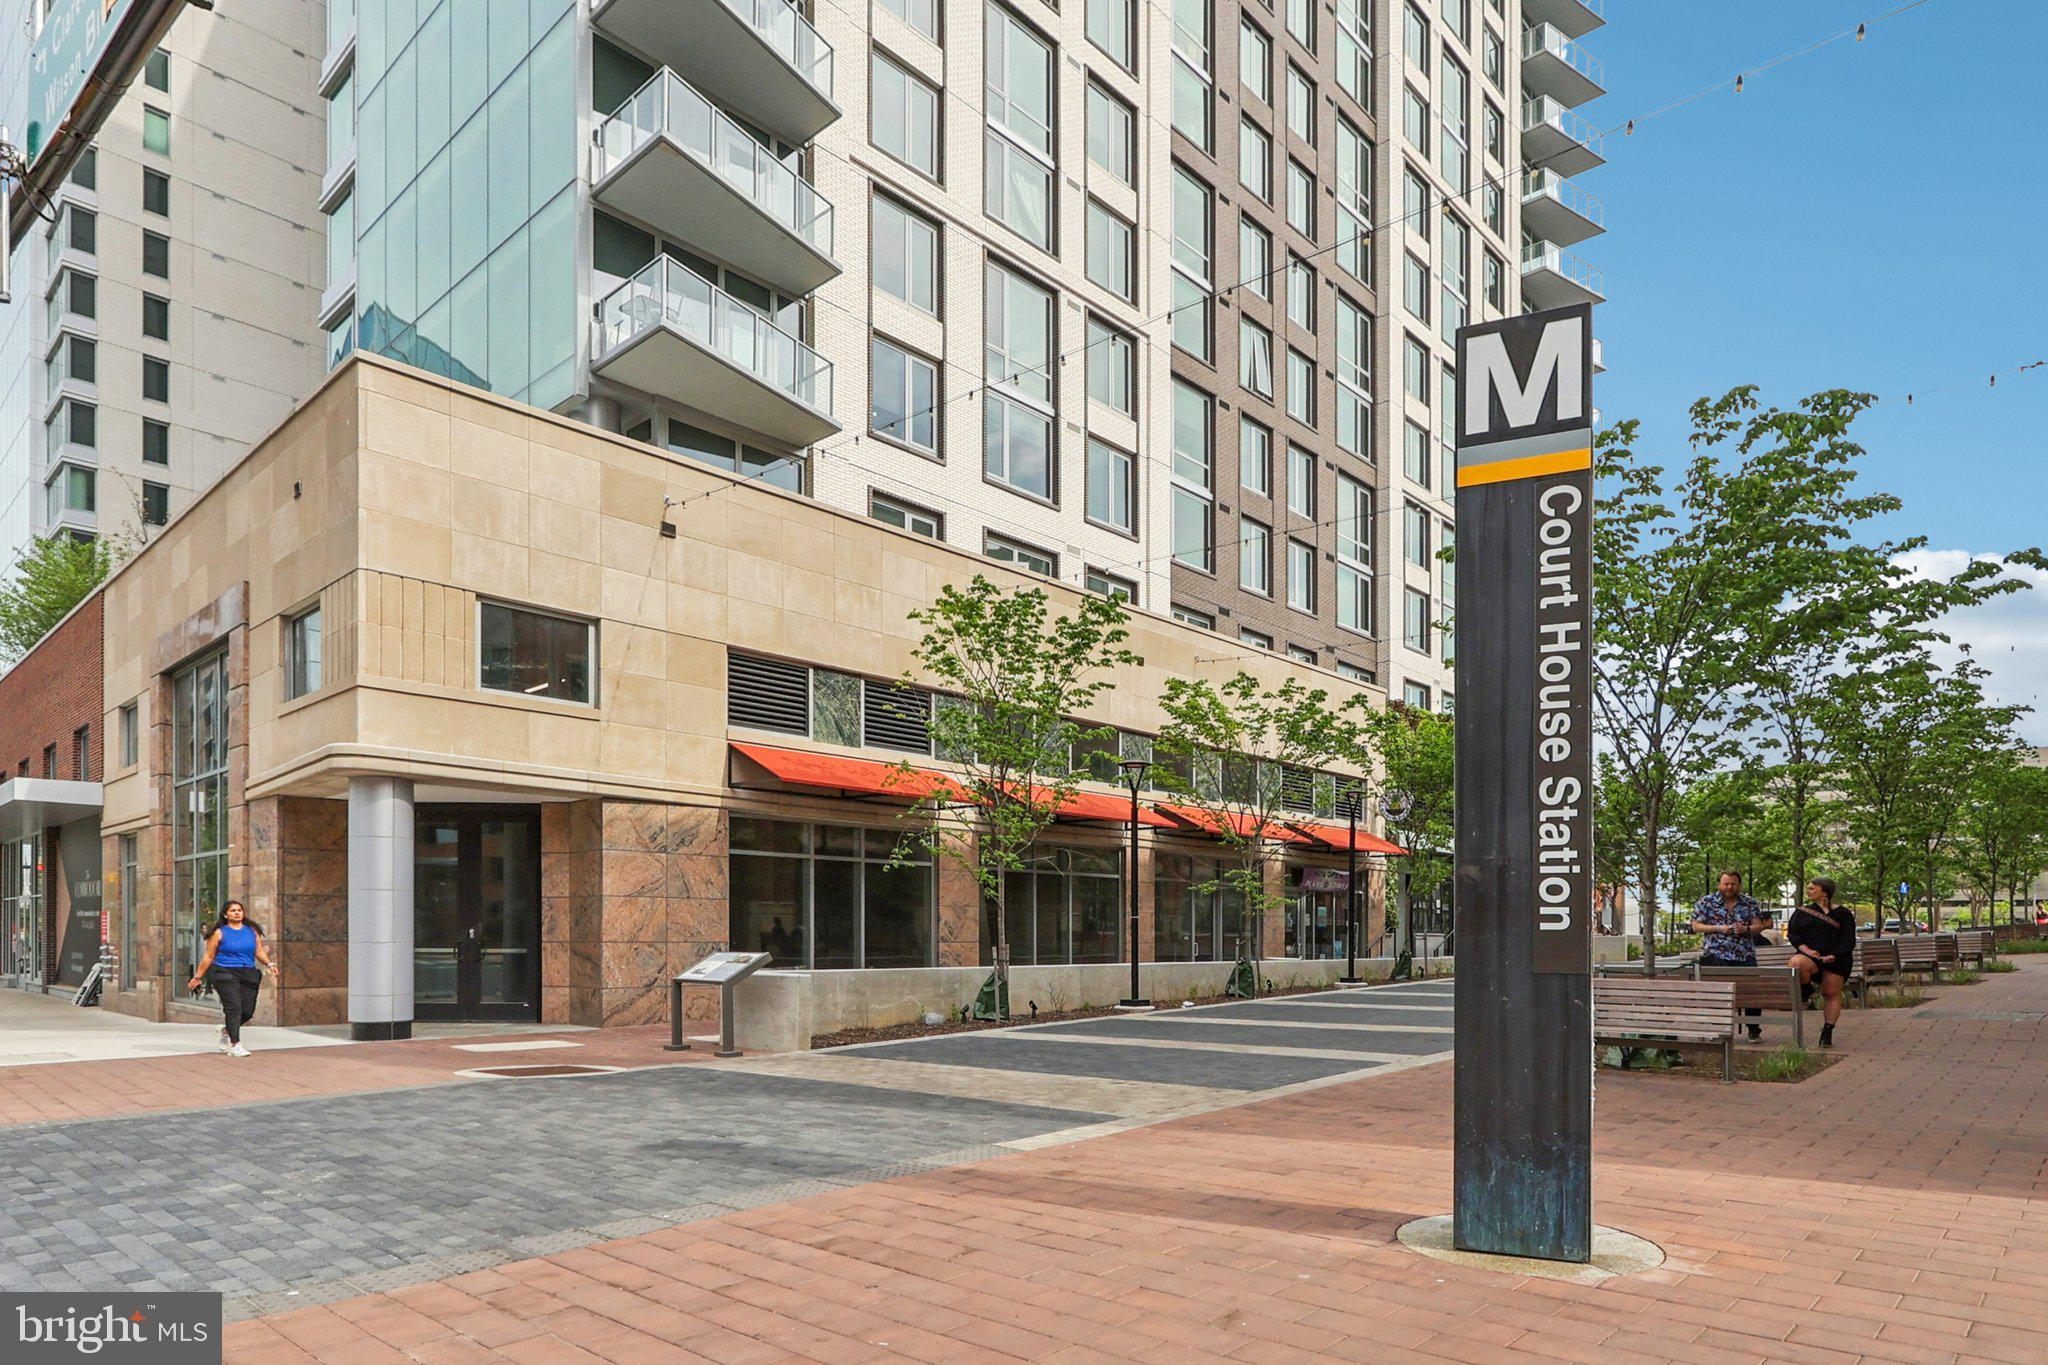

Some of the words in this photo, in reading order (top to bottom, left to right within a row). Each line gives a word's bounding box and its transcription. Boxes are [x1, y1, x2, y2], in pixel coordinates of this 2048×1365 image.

[45, 52, 82, 123] Wilson
[86, 6, 105, 57] Bl
[1464, 316, 1583, 437] M
[1539, 484, 1583, 610] Court
[1539, 621, 1582, 763] House
[1538, 776, 1582, 931] Station
